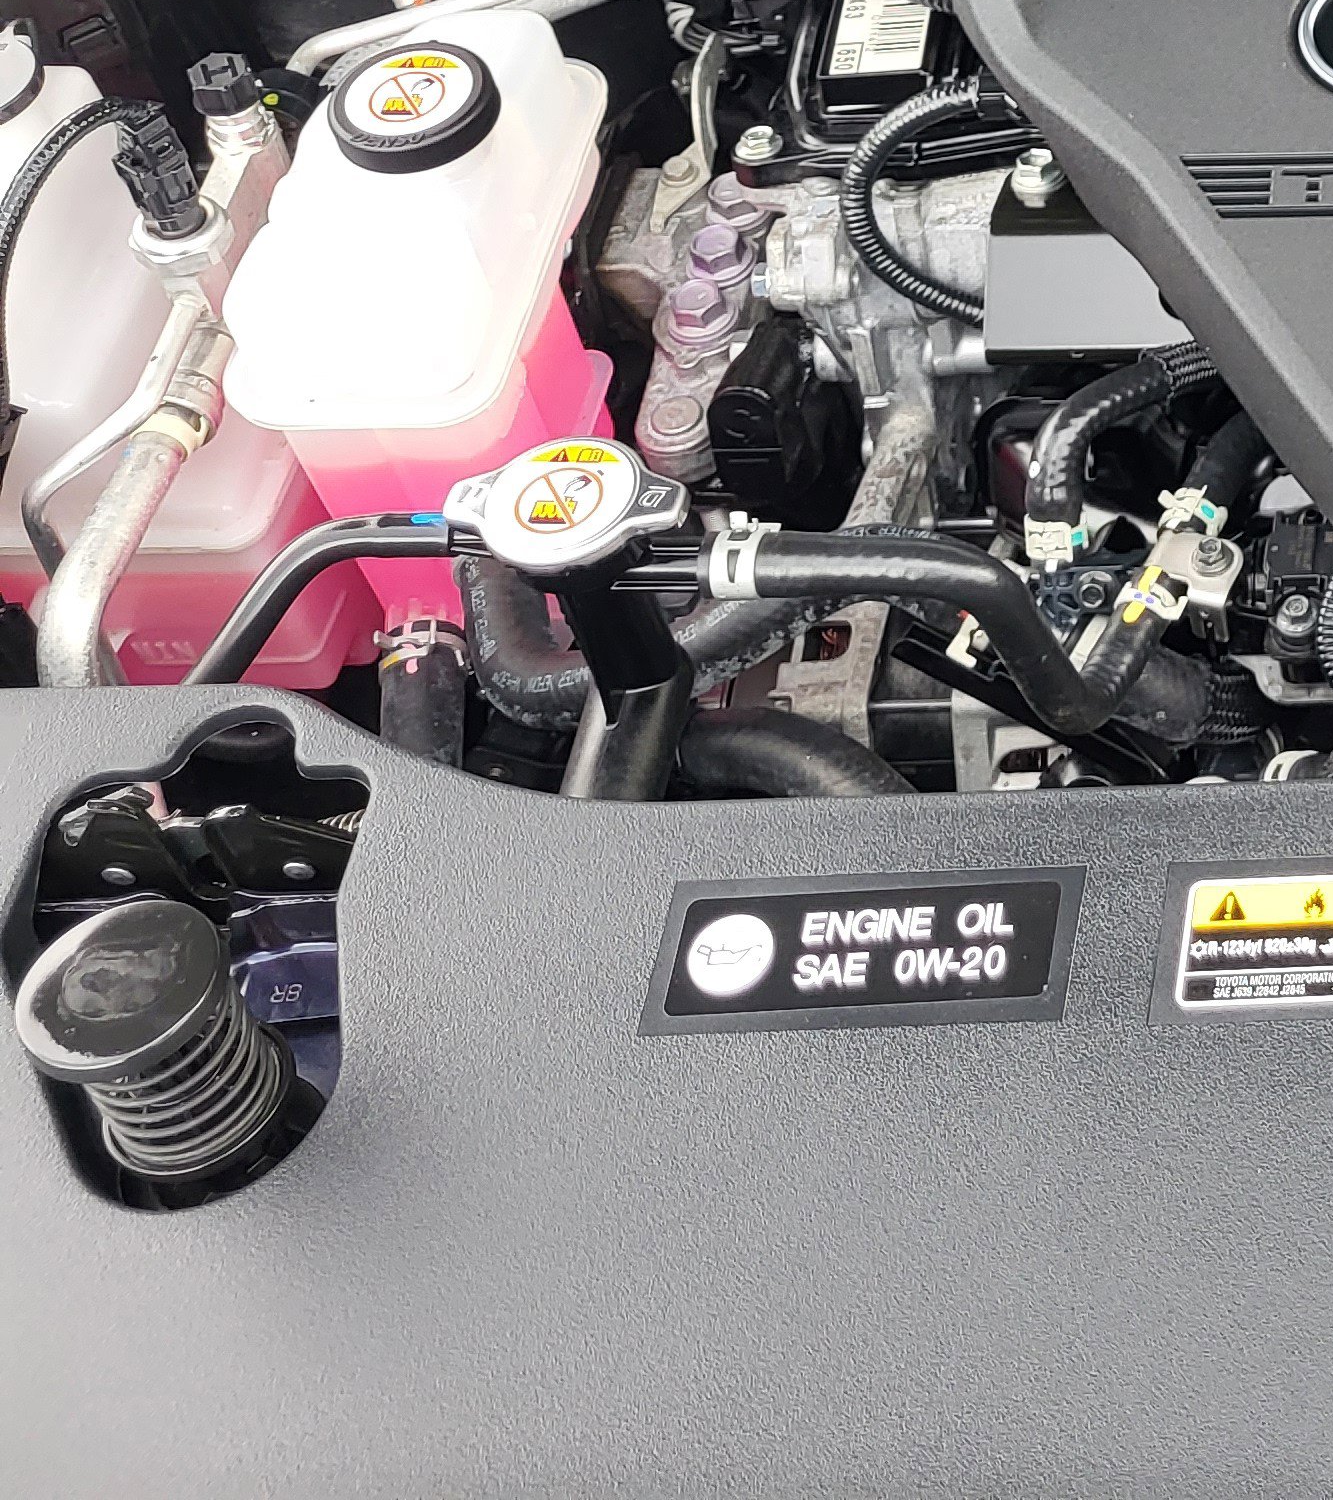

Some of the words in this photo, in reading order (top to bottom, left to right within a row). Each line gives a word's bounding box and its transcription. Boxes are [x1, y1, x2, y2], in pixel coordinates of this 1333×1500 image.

[350, 132, 426, 148] DENSO
[800, 905, 937, 946] ENGINE
[956, 902, 1015, 938] OIL
[792, 951, 870, 989] SAE
[893, 944, 1007, 986] 0W-20
[1214, 975, 1249, 987] TOYOTA
[1249, 974, 1282, 986] MOTOR
[1213, 986, 1231, 998] SAE
[1231, 985, 1253, 998] J639
